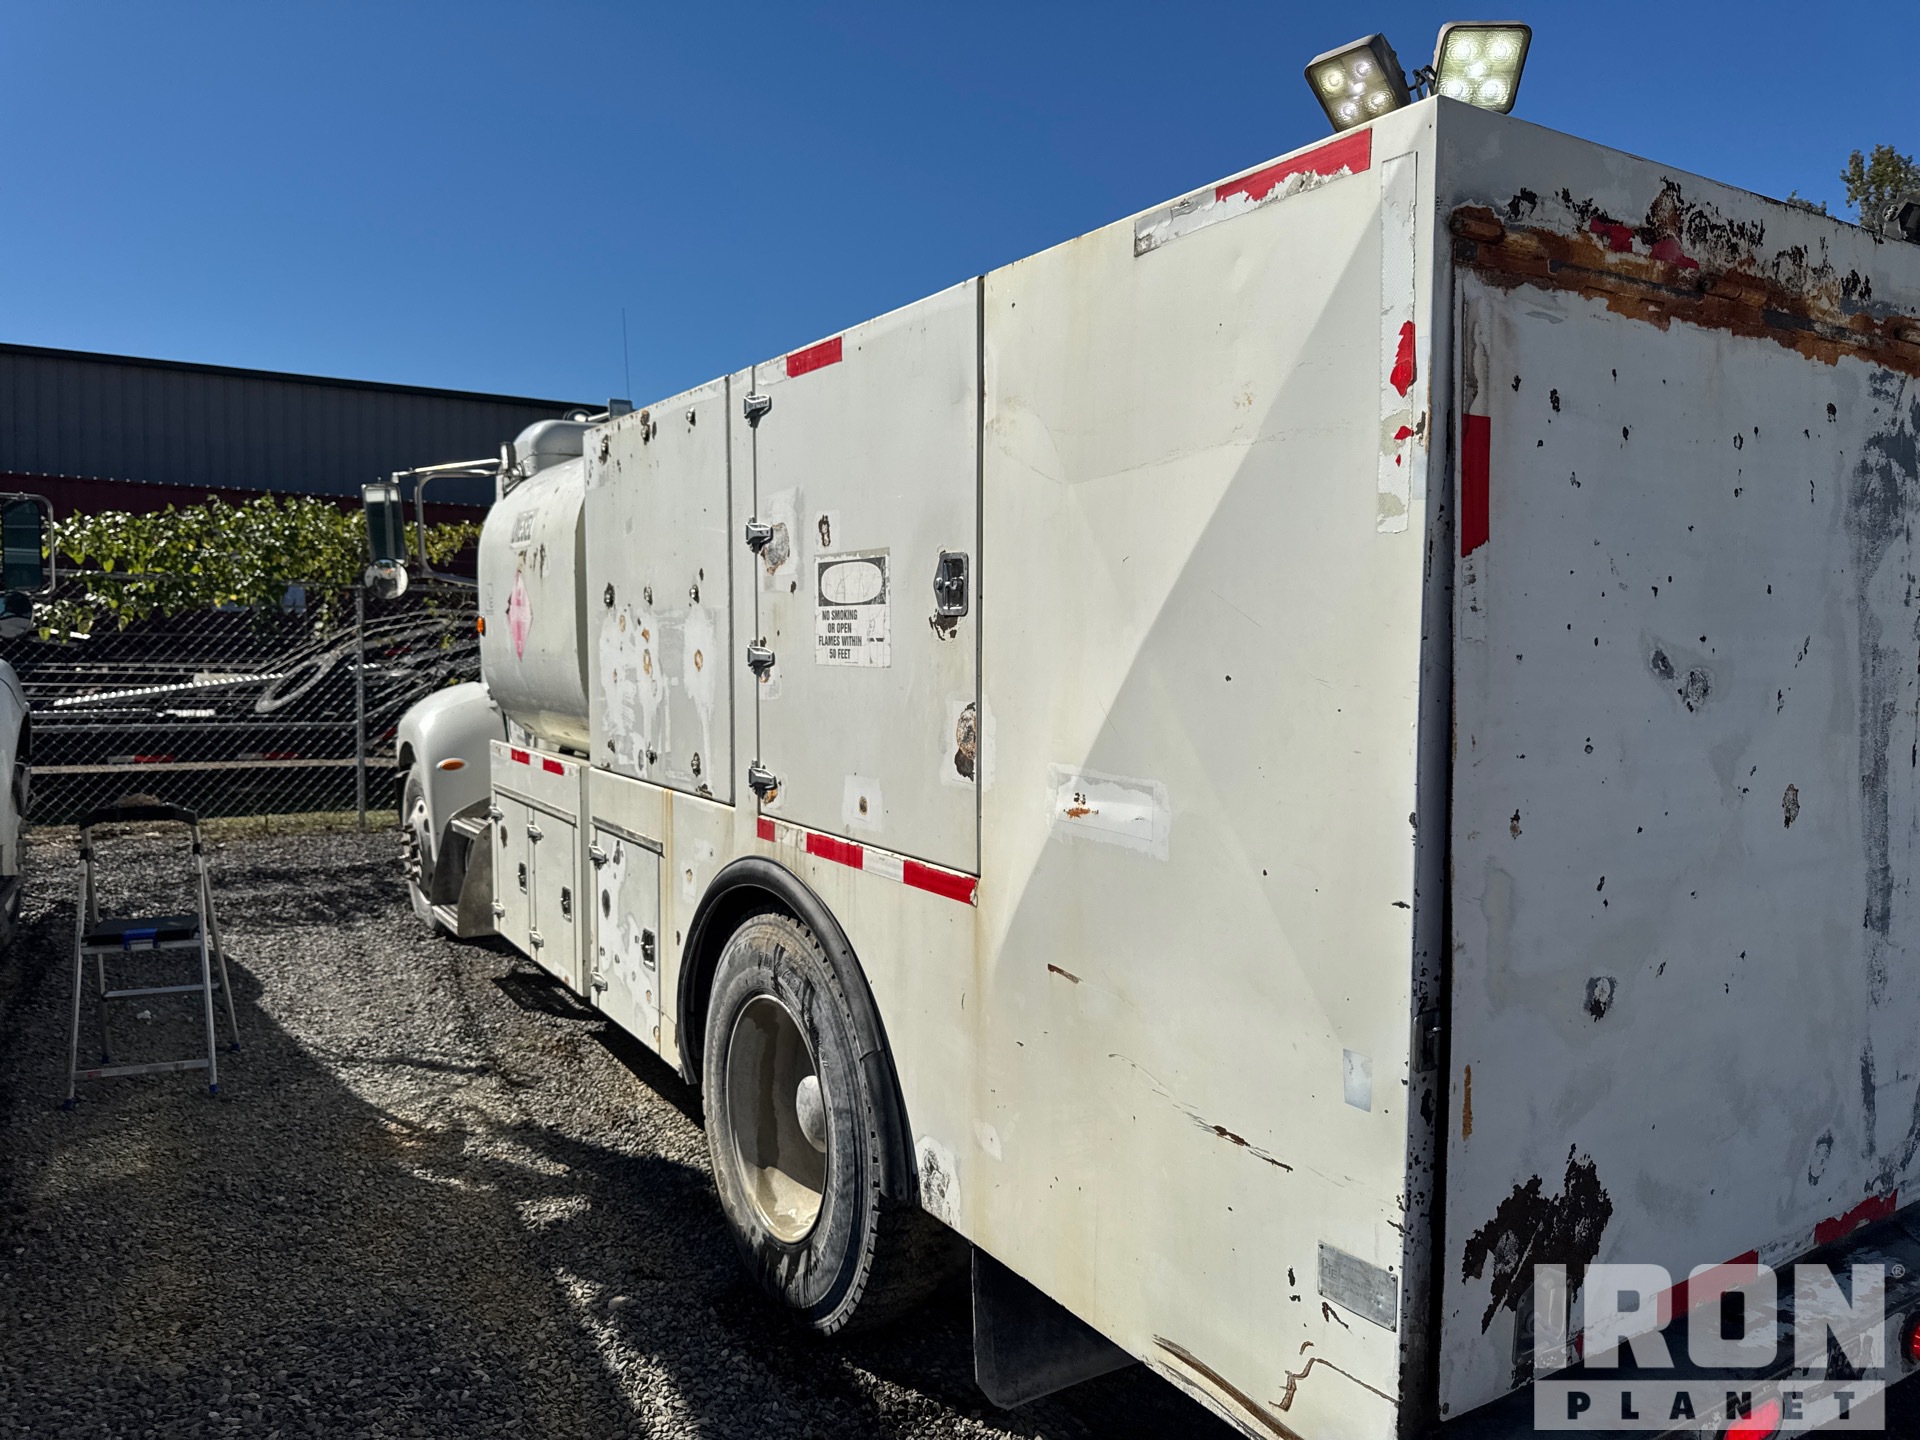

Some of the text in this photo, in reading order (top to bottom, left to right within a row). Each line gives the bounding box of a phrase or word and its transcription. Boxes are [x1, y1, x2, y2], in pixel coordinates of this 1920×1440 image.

[822, 609, 857, 620] NO SMOKING
[828, 622, 851, 633] OR OPEN
[819, 635, 862, 646] FLAMES WITHIN
[829, 648, 850, 659] 50 FEET
[1321, 1257, 1338, 1279] CTE
